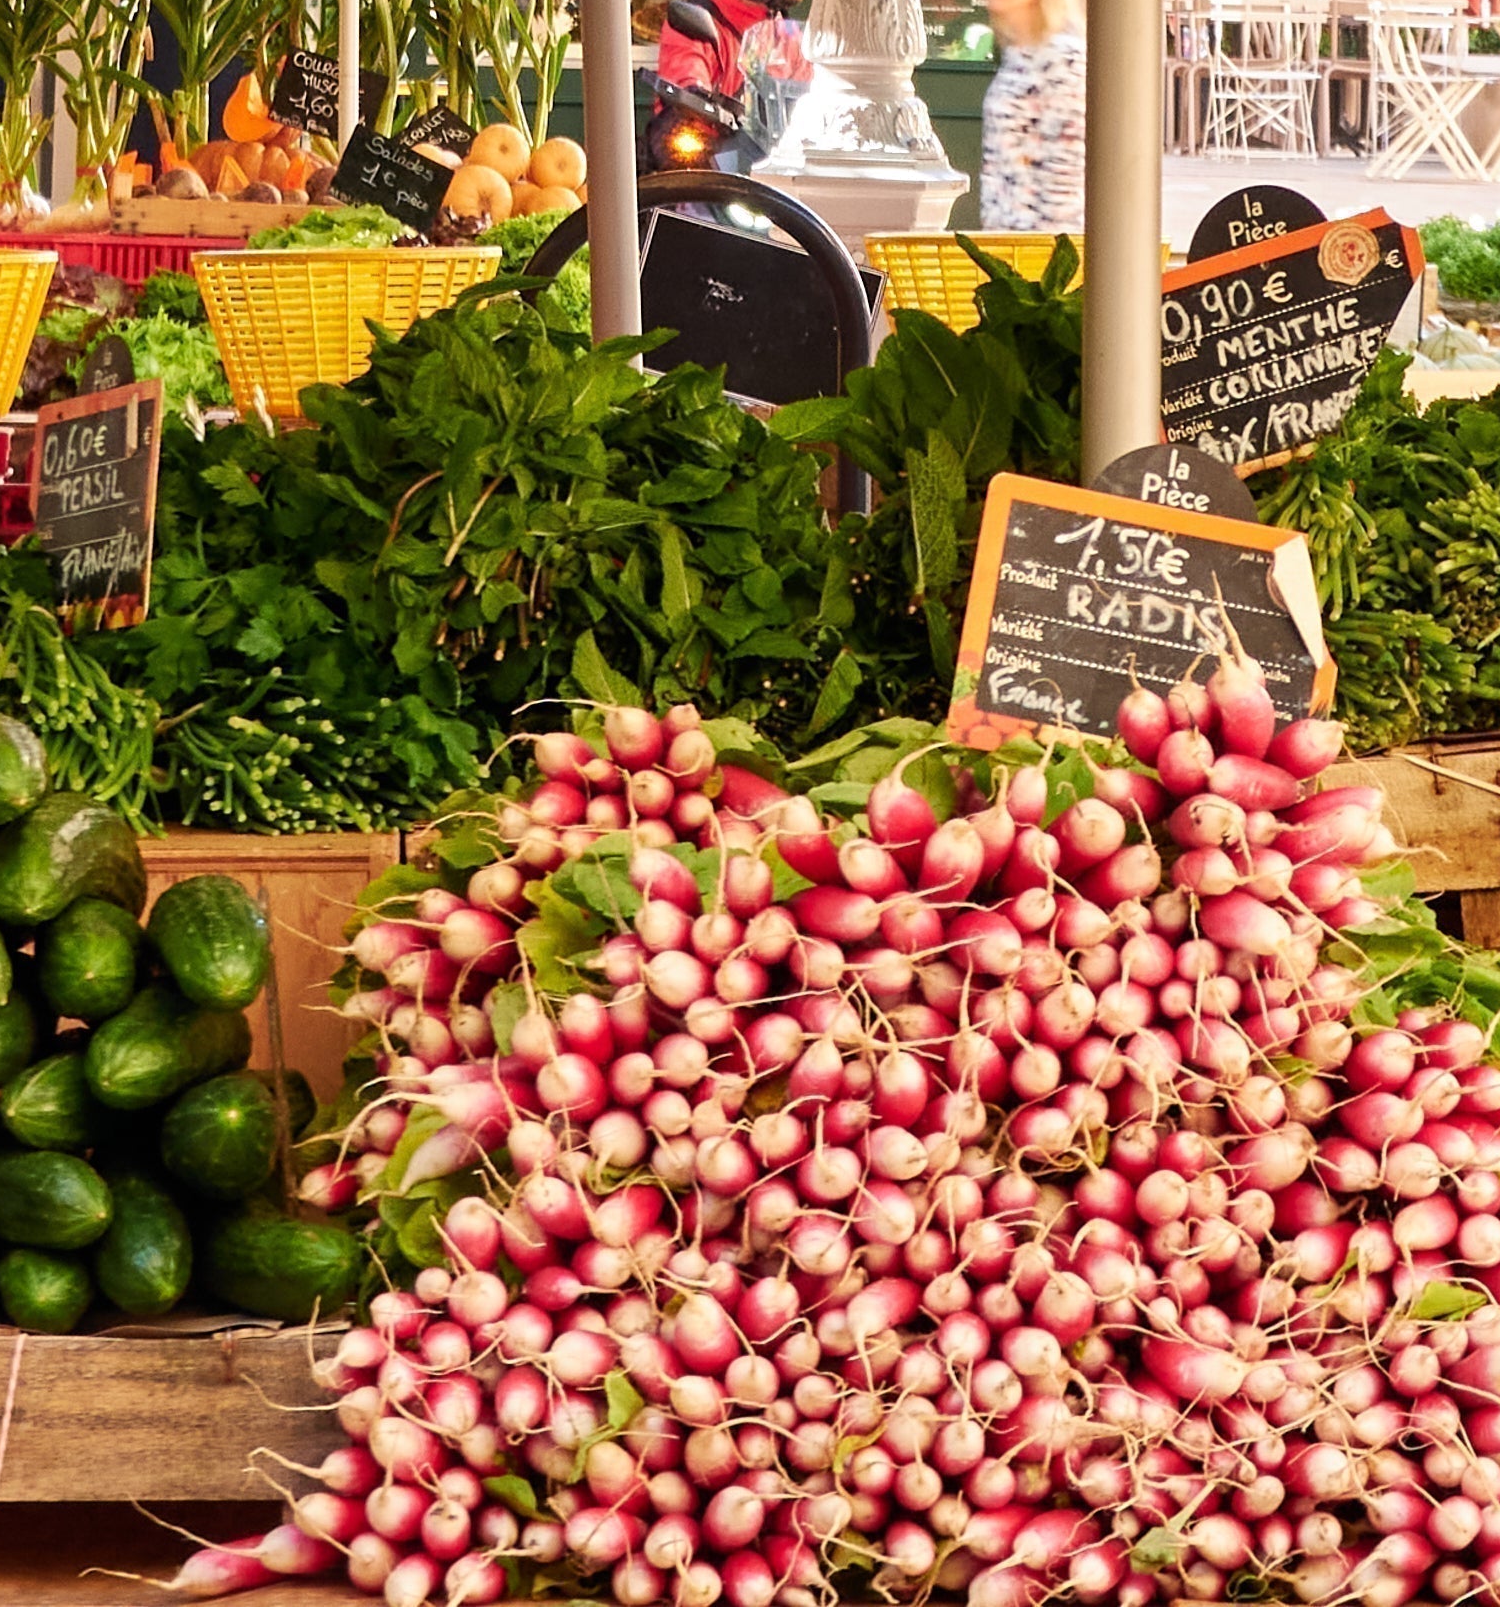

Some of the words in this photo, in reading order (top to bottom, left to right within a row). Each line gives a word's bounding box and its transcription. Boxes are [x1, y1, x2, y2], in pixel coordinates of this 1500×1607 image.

[365, 136, 434, 183] Salades
[1243, 192, 1264, 219] la
[1228, 218, 1288, 247] Pièce
[1384, 248, 1404, 269] €
[1162, 344, 1199, 368] oduit
[1216, 297, 1360, 368] MENTHE
[1161, 388, 1205, 417] Variété
[1208, 325, 1384, 407] CORIANDRE
[1167, 418, 1215, 443] Origine
[1167, 448, 1190, 481] la
[1140, 472, 1211, 512] Pièce
[999, 563, 1059, 591] Produit
[1066, 583, 1228, 655] RADIS
[991, 613, 1044, 643] Variété
[985, 645, 1043, 675] Origine
